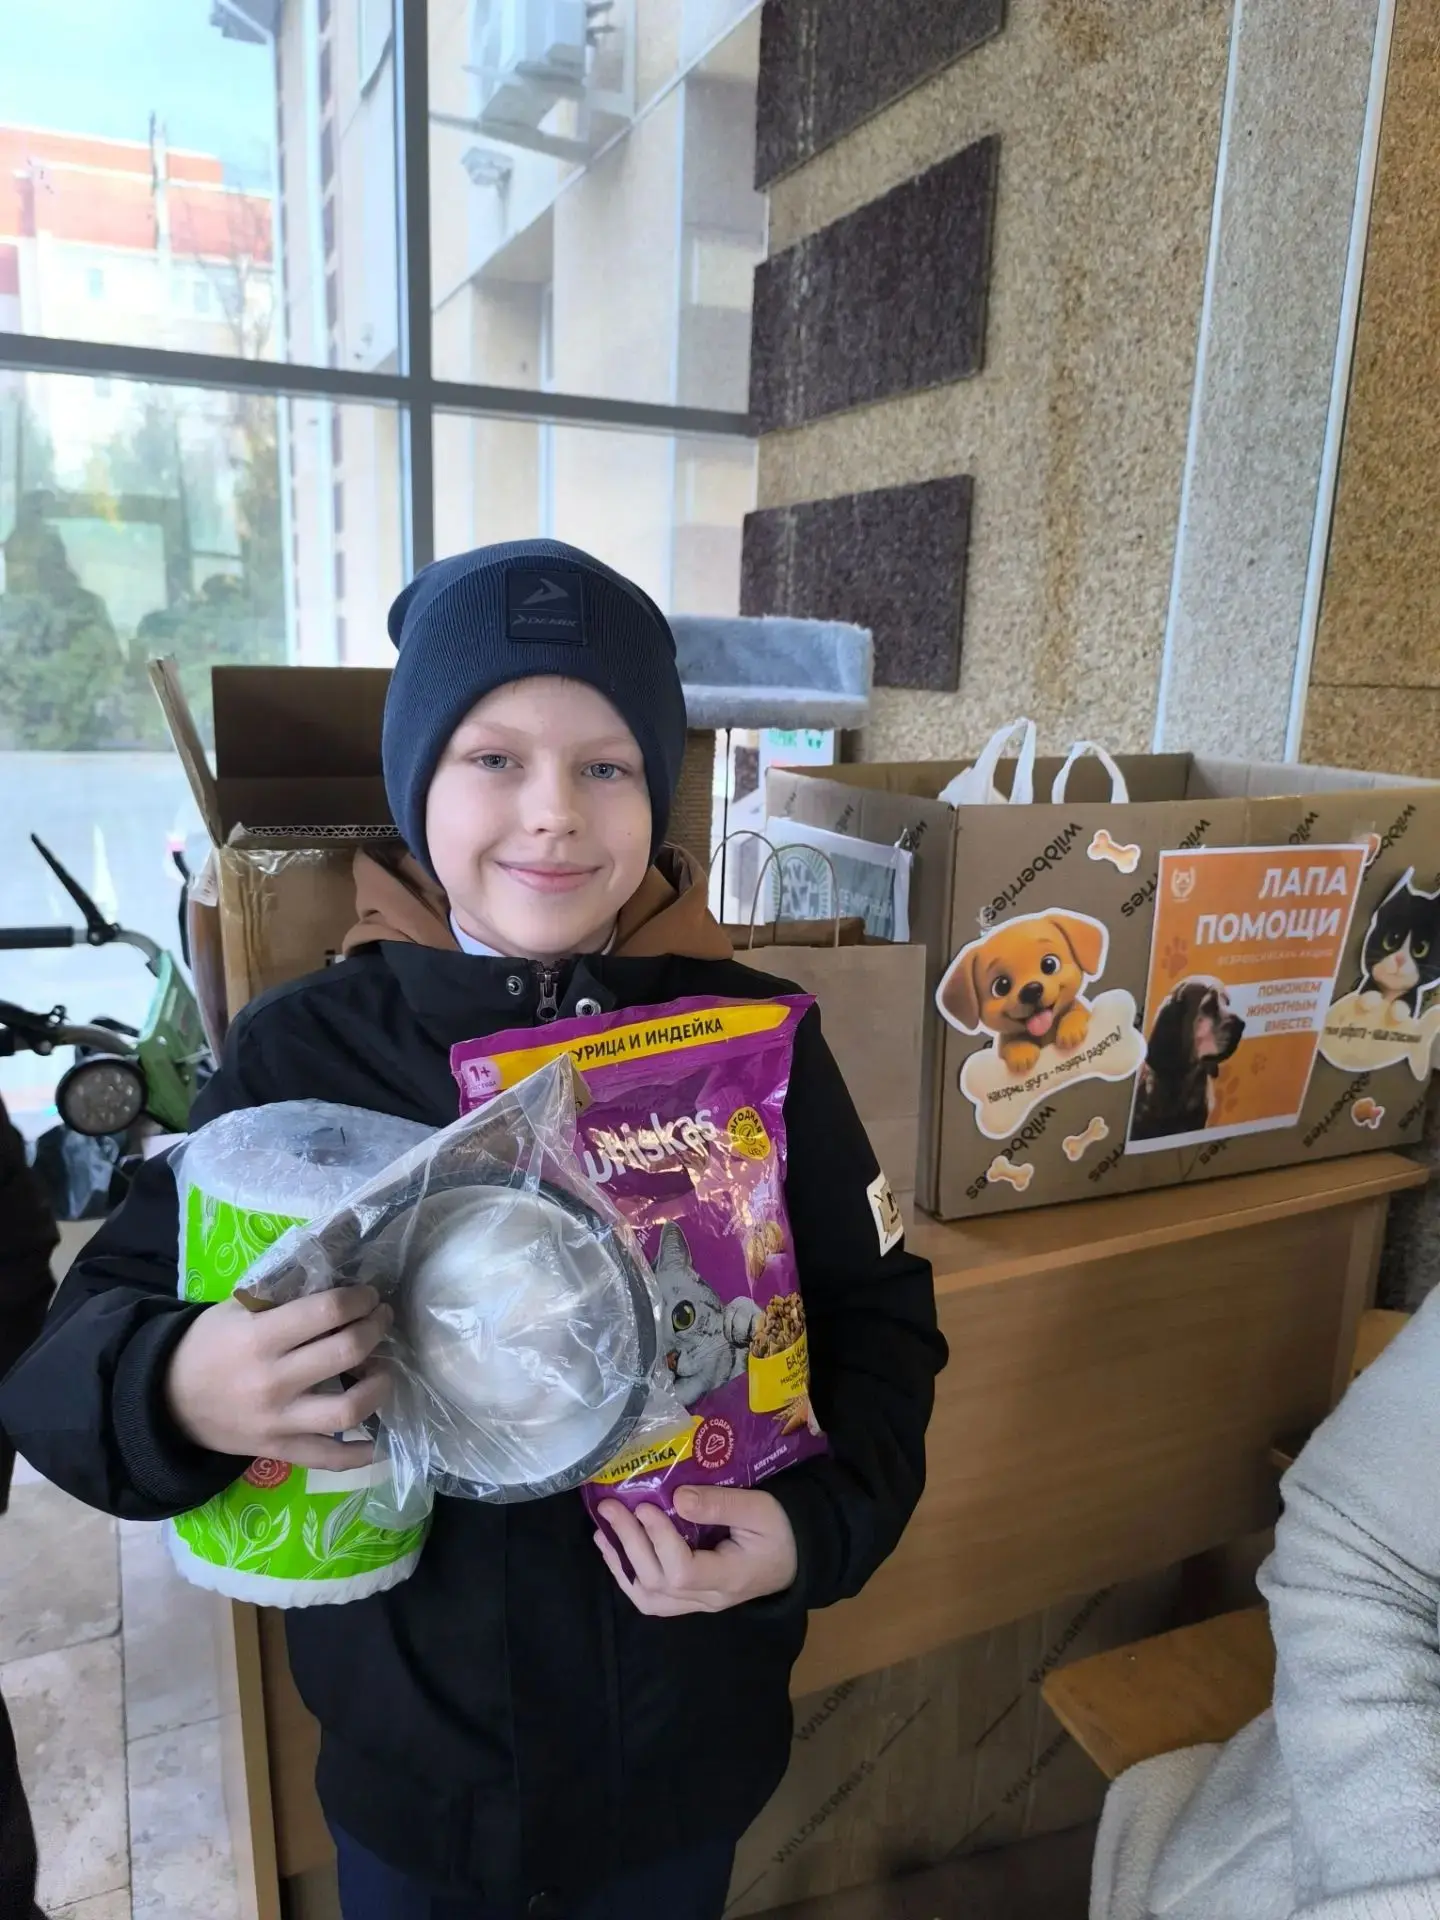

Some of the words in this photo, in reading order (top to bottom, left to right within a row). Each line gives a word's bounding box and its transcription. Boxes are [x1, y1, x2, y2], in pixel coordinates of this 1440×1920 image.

[983, 822, 1083, 921] wildberries
[1258, 866, 1348, 900] ЛАПА
[1195, 908, 1341, 945] ПОМОЩИ
[1257, 981, 1322, 998] ПОМОЖЕМ
[1246, 1000, 1318, 1018] ЖИВОТНЫМ
[570, 1037, 625, 1062] УРИЦА
[629, 1034, 641, 1050] И
[645, 1018, 723, 1046] ИНДЕЙКА
[469, 1065, 491, 1082] 1+
